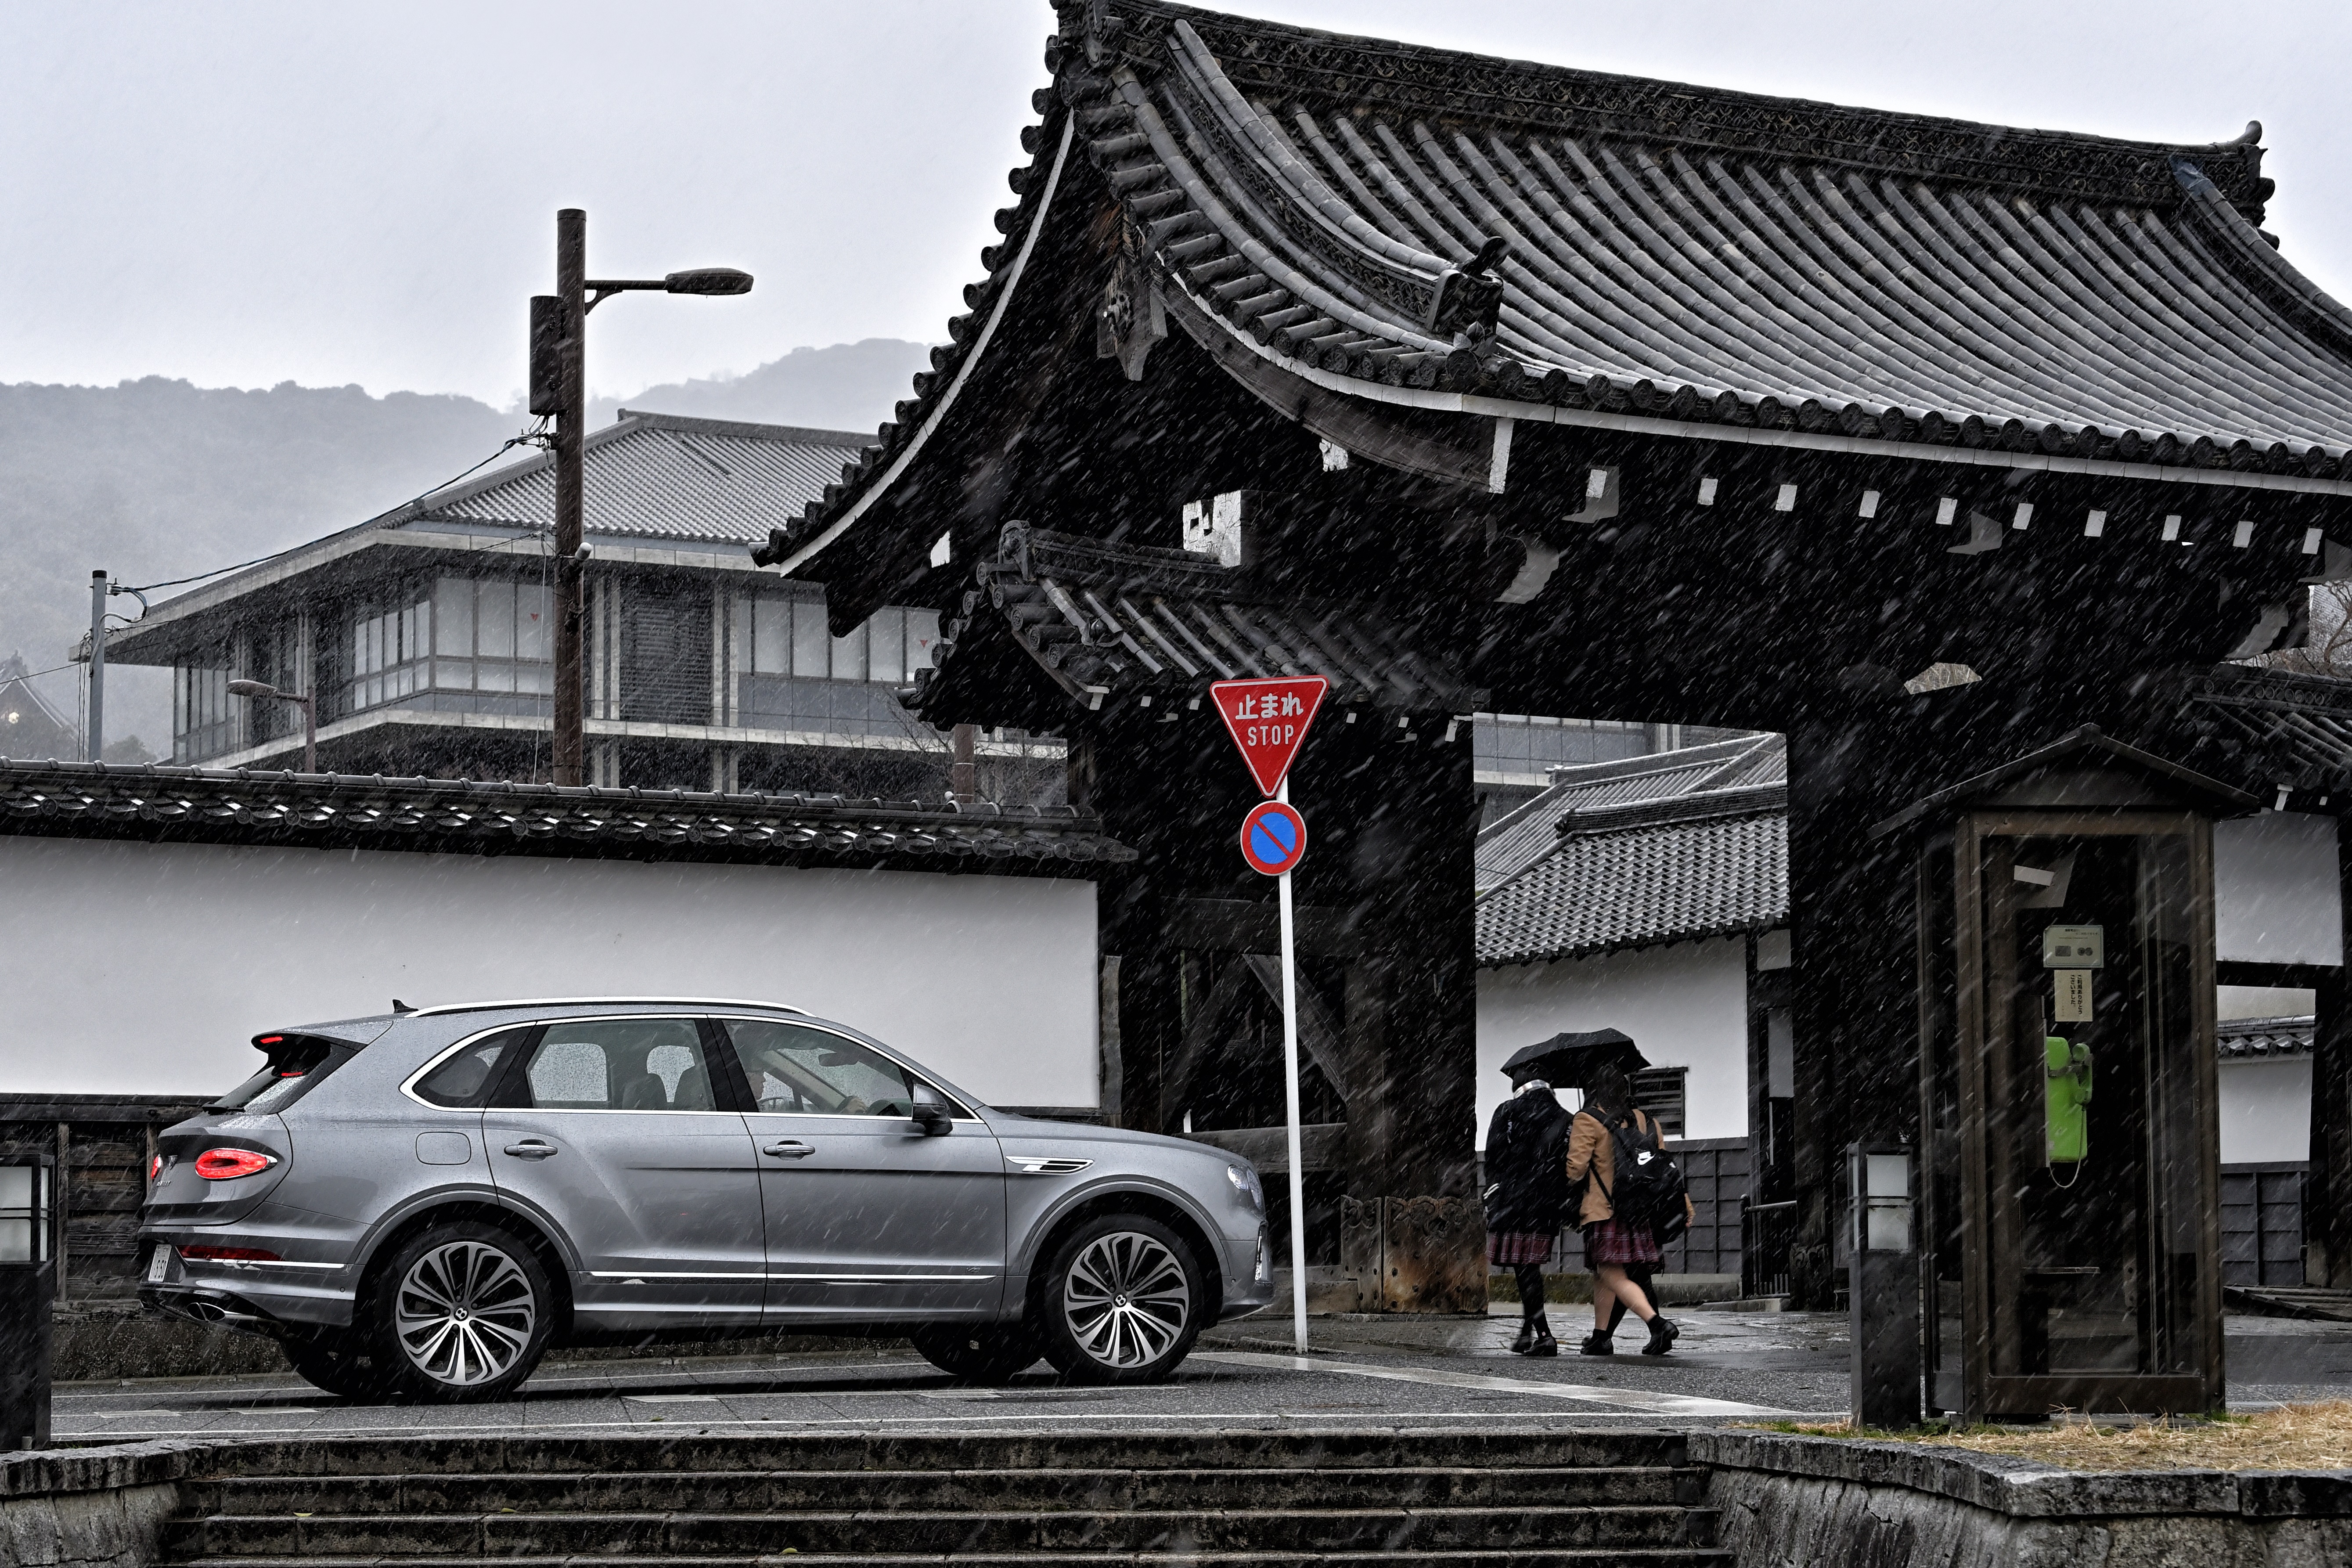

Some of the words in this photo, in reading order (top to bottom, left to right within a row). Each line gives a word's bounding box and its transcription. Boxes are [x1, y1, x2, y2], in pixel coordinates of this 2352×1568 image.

[1235, 692, 1304, 720] 止まれ
[1248, 725, 1294, 746] STOP
